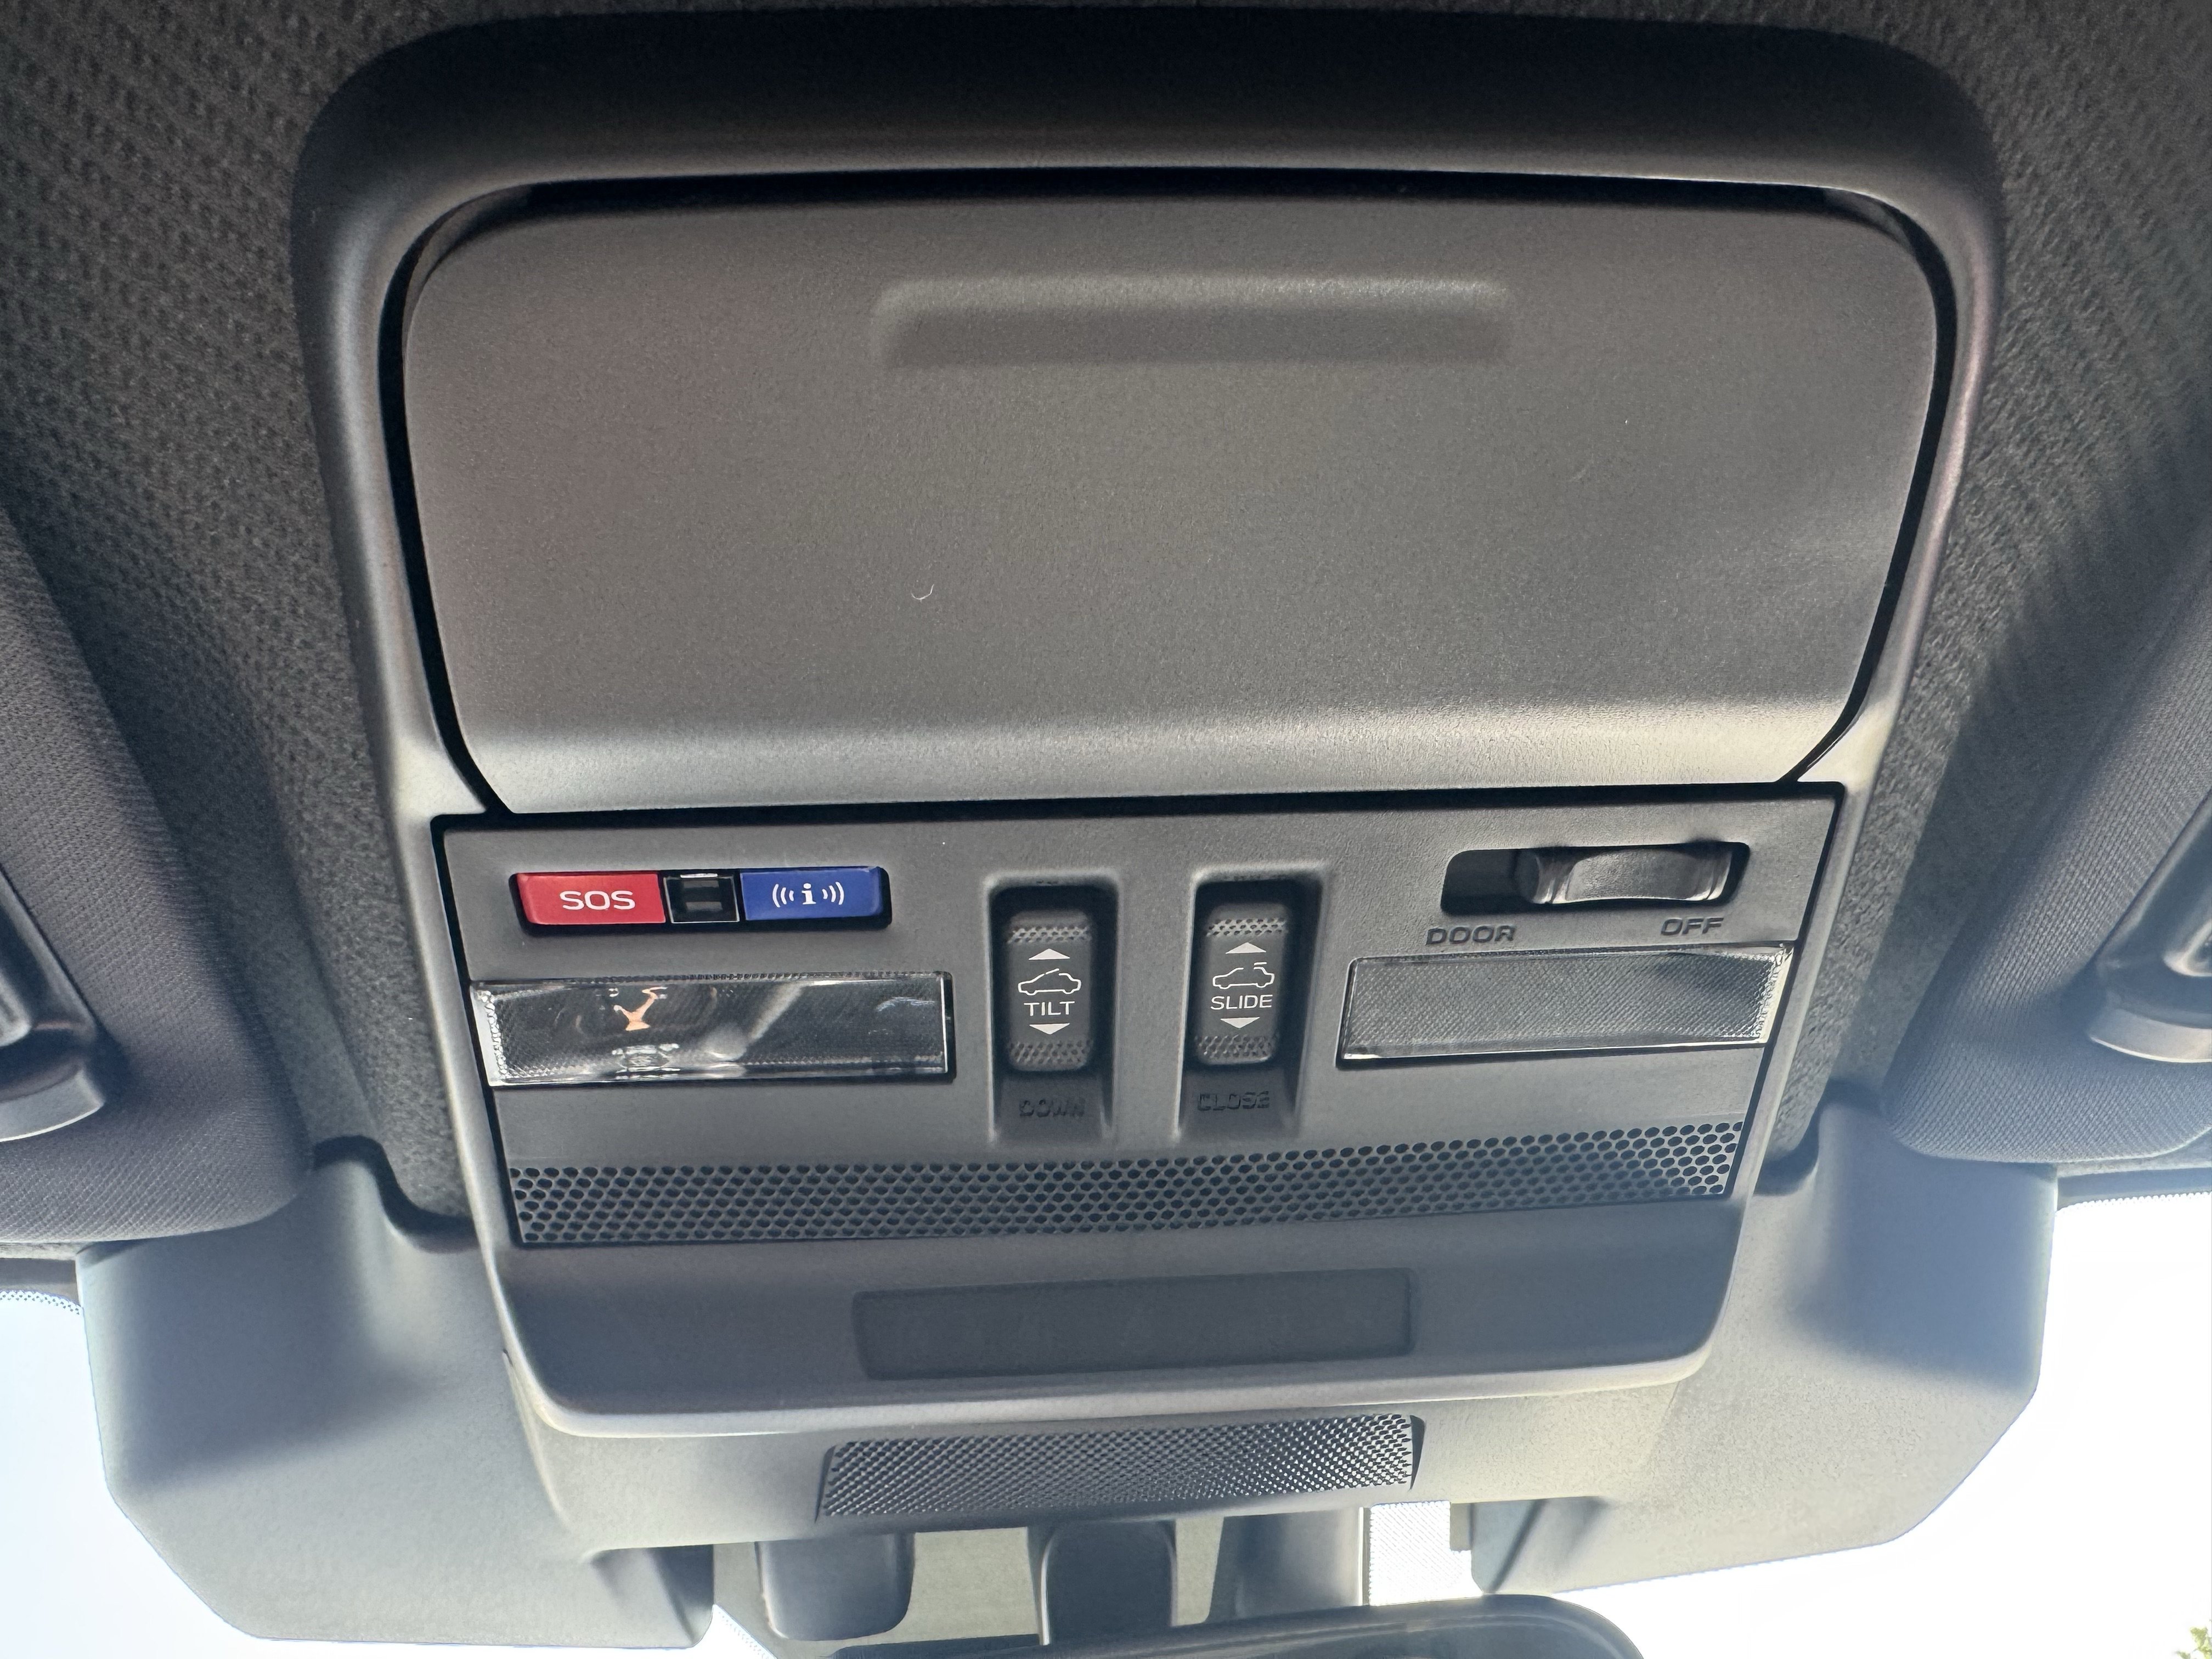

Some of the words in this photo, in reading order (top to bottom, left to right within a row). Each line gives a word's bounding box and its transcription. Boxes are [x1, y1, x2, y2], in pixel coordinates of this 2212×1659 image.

[560, 890, 635, 910] SOS
[1426, 924, 1516, 945] DOOR
[1660, 917, 1724, 935] OFF
[1024, 1001, 1075, 1017] TILT
[1210, 994, 1273, 1011] SLIDE
[1019, 1099, 1085, 1118] DOWN
[1197, 1091, 1269, 1111] CLOSE
